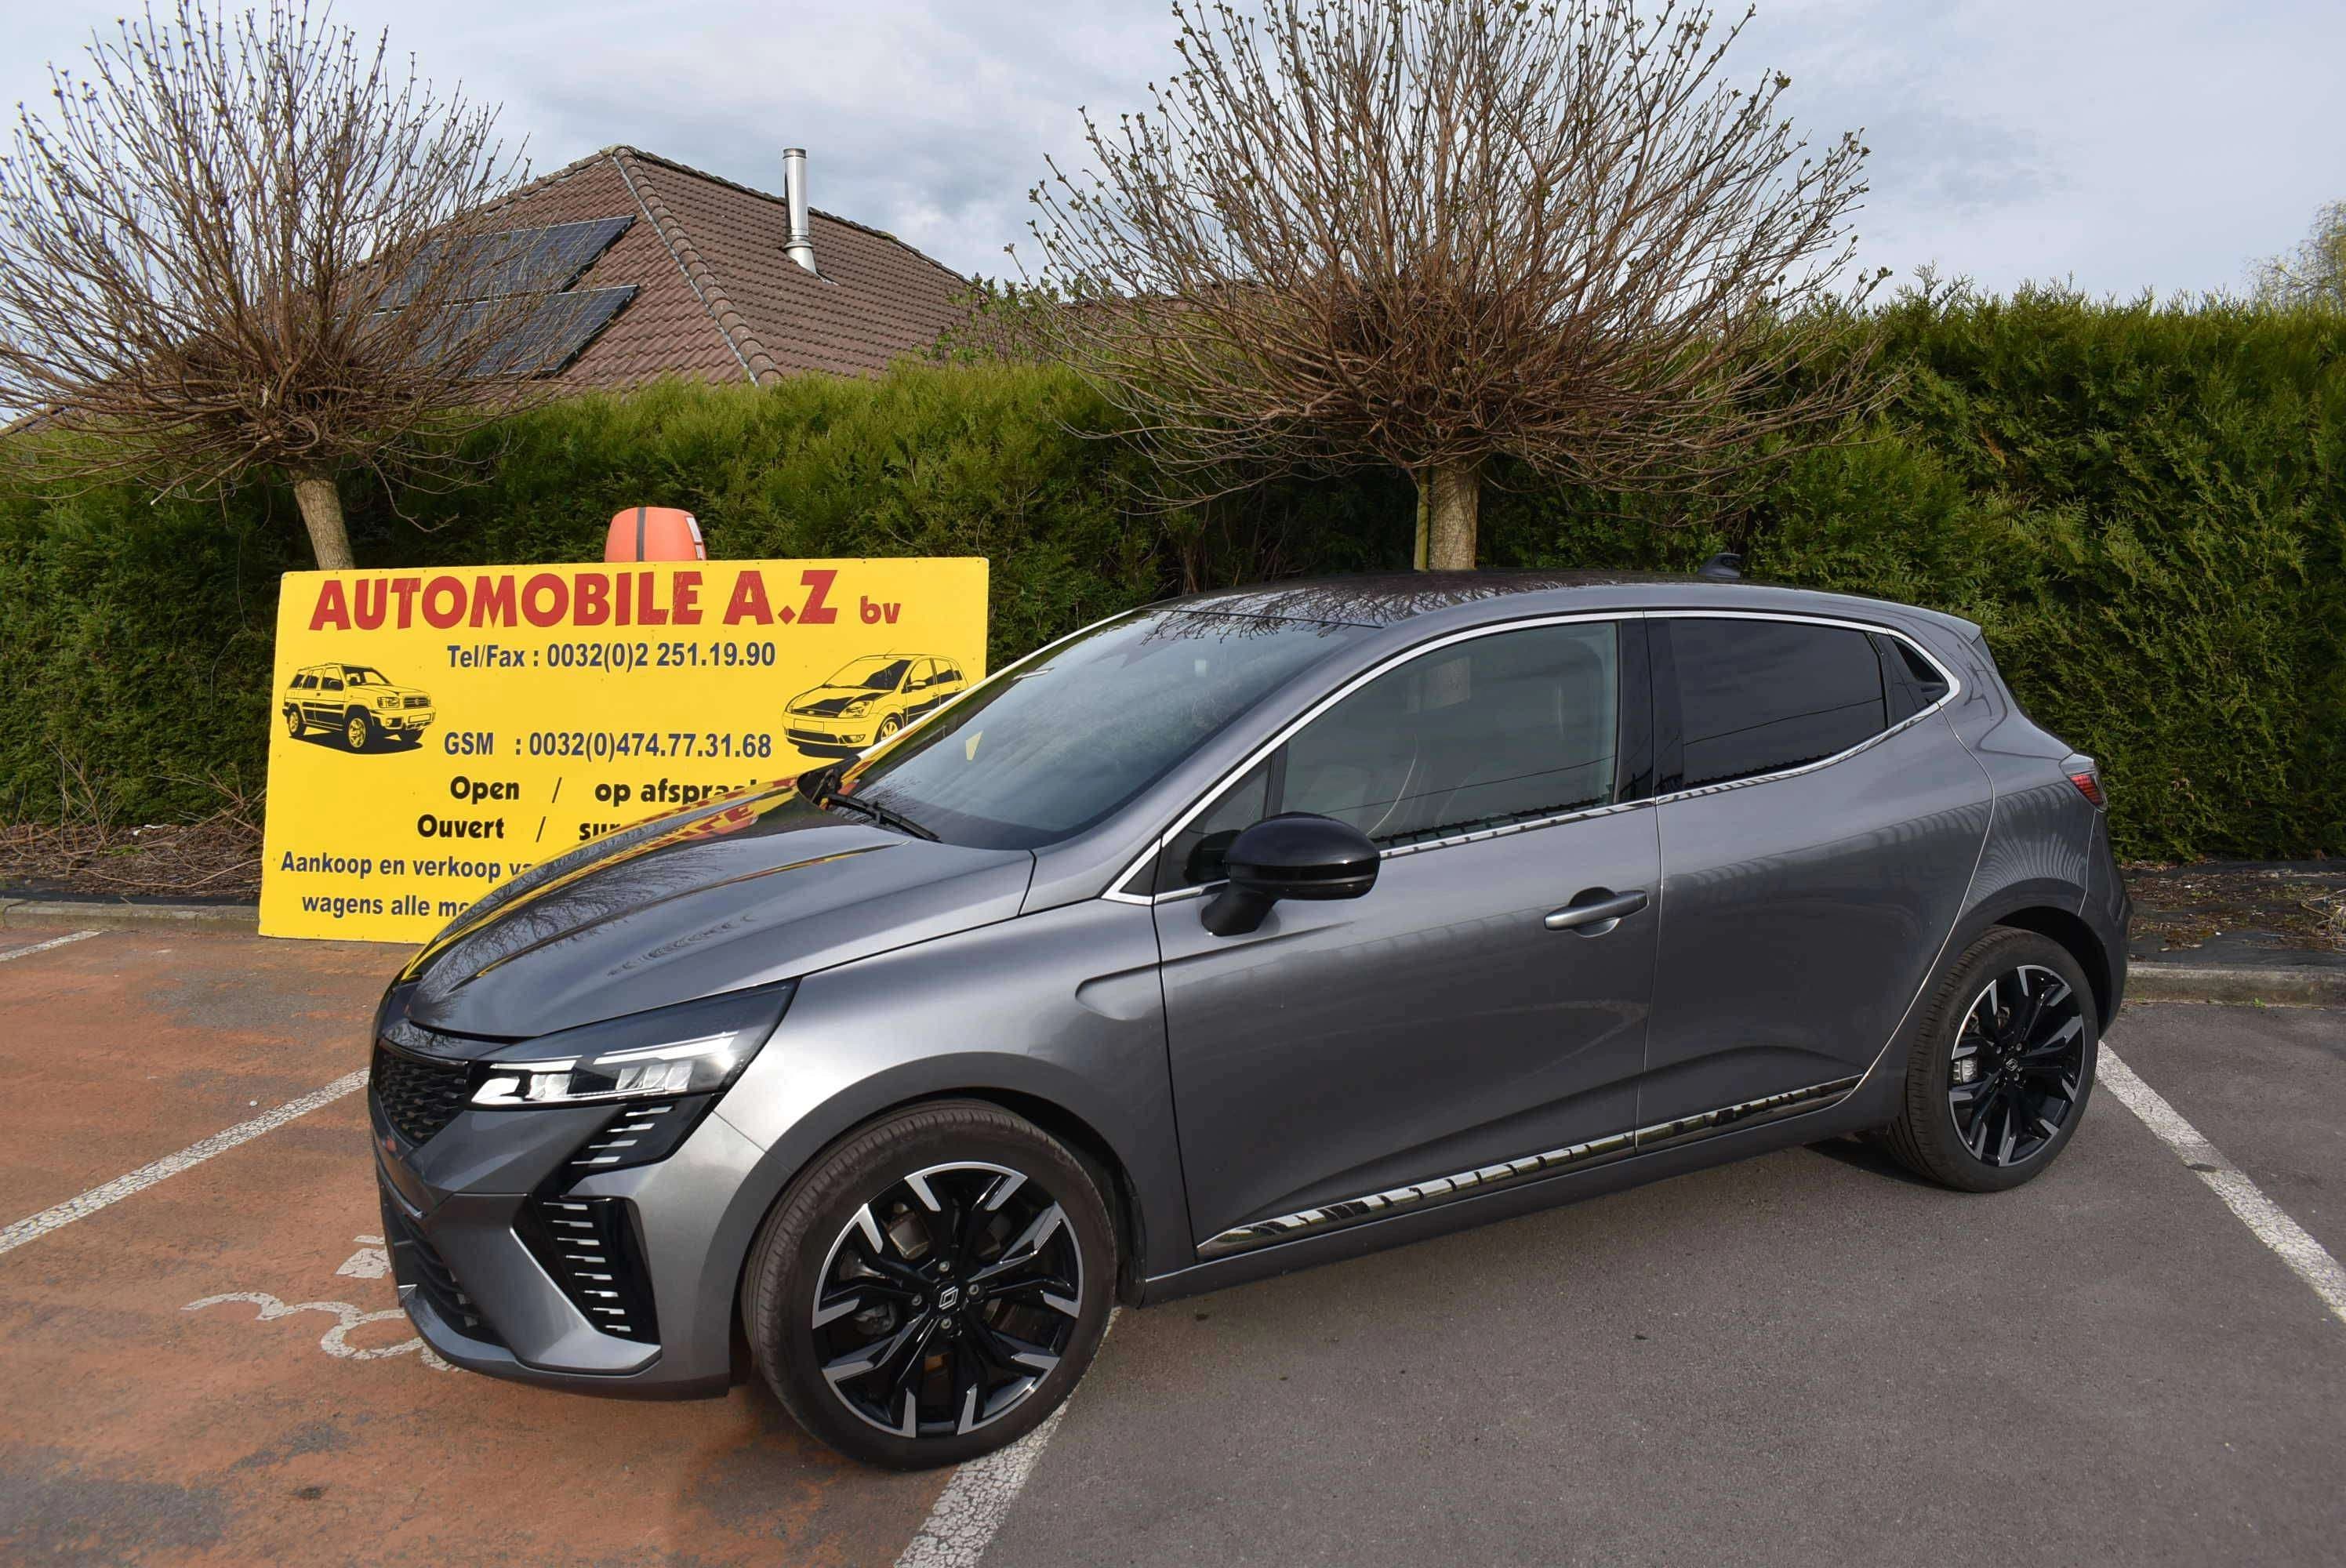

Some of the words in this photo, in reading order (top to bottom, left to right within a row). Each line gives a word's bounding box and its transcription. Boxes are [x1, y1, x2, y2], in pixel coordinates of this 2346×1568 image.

[307, 571, 703, 631] AUTOMOBILE
[723, 569, 838, 626] A.Z
[860, 595, 901, 625] bv
[447, 644, 525, 668] Tel/Fax
[547, 642, 648, 673] 0032(0)2
[656, 642, 775, 666] 251.19.90
[444, 731, 494, 755] GSM
[529, 732, 772, 763] 0032(0)474.77.31.68
[450, 775, 520, 805] Open
[551, 777, 562, 804] /
[594, 783, 631, 808] op
[417, 814, 504, 839] Ouvert
[536, 816, 547, 843] /
[281, 851, 372, 880] Aankoop
[380, 858, 405, 876] en
[412, 855, 501, 884] verkoop
[302, 896, 383, 919] wagens
[390, 895, 430, 916] alle
